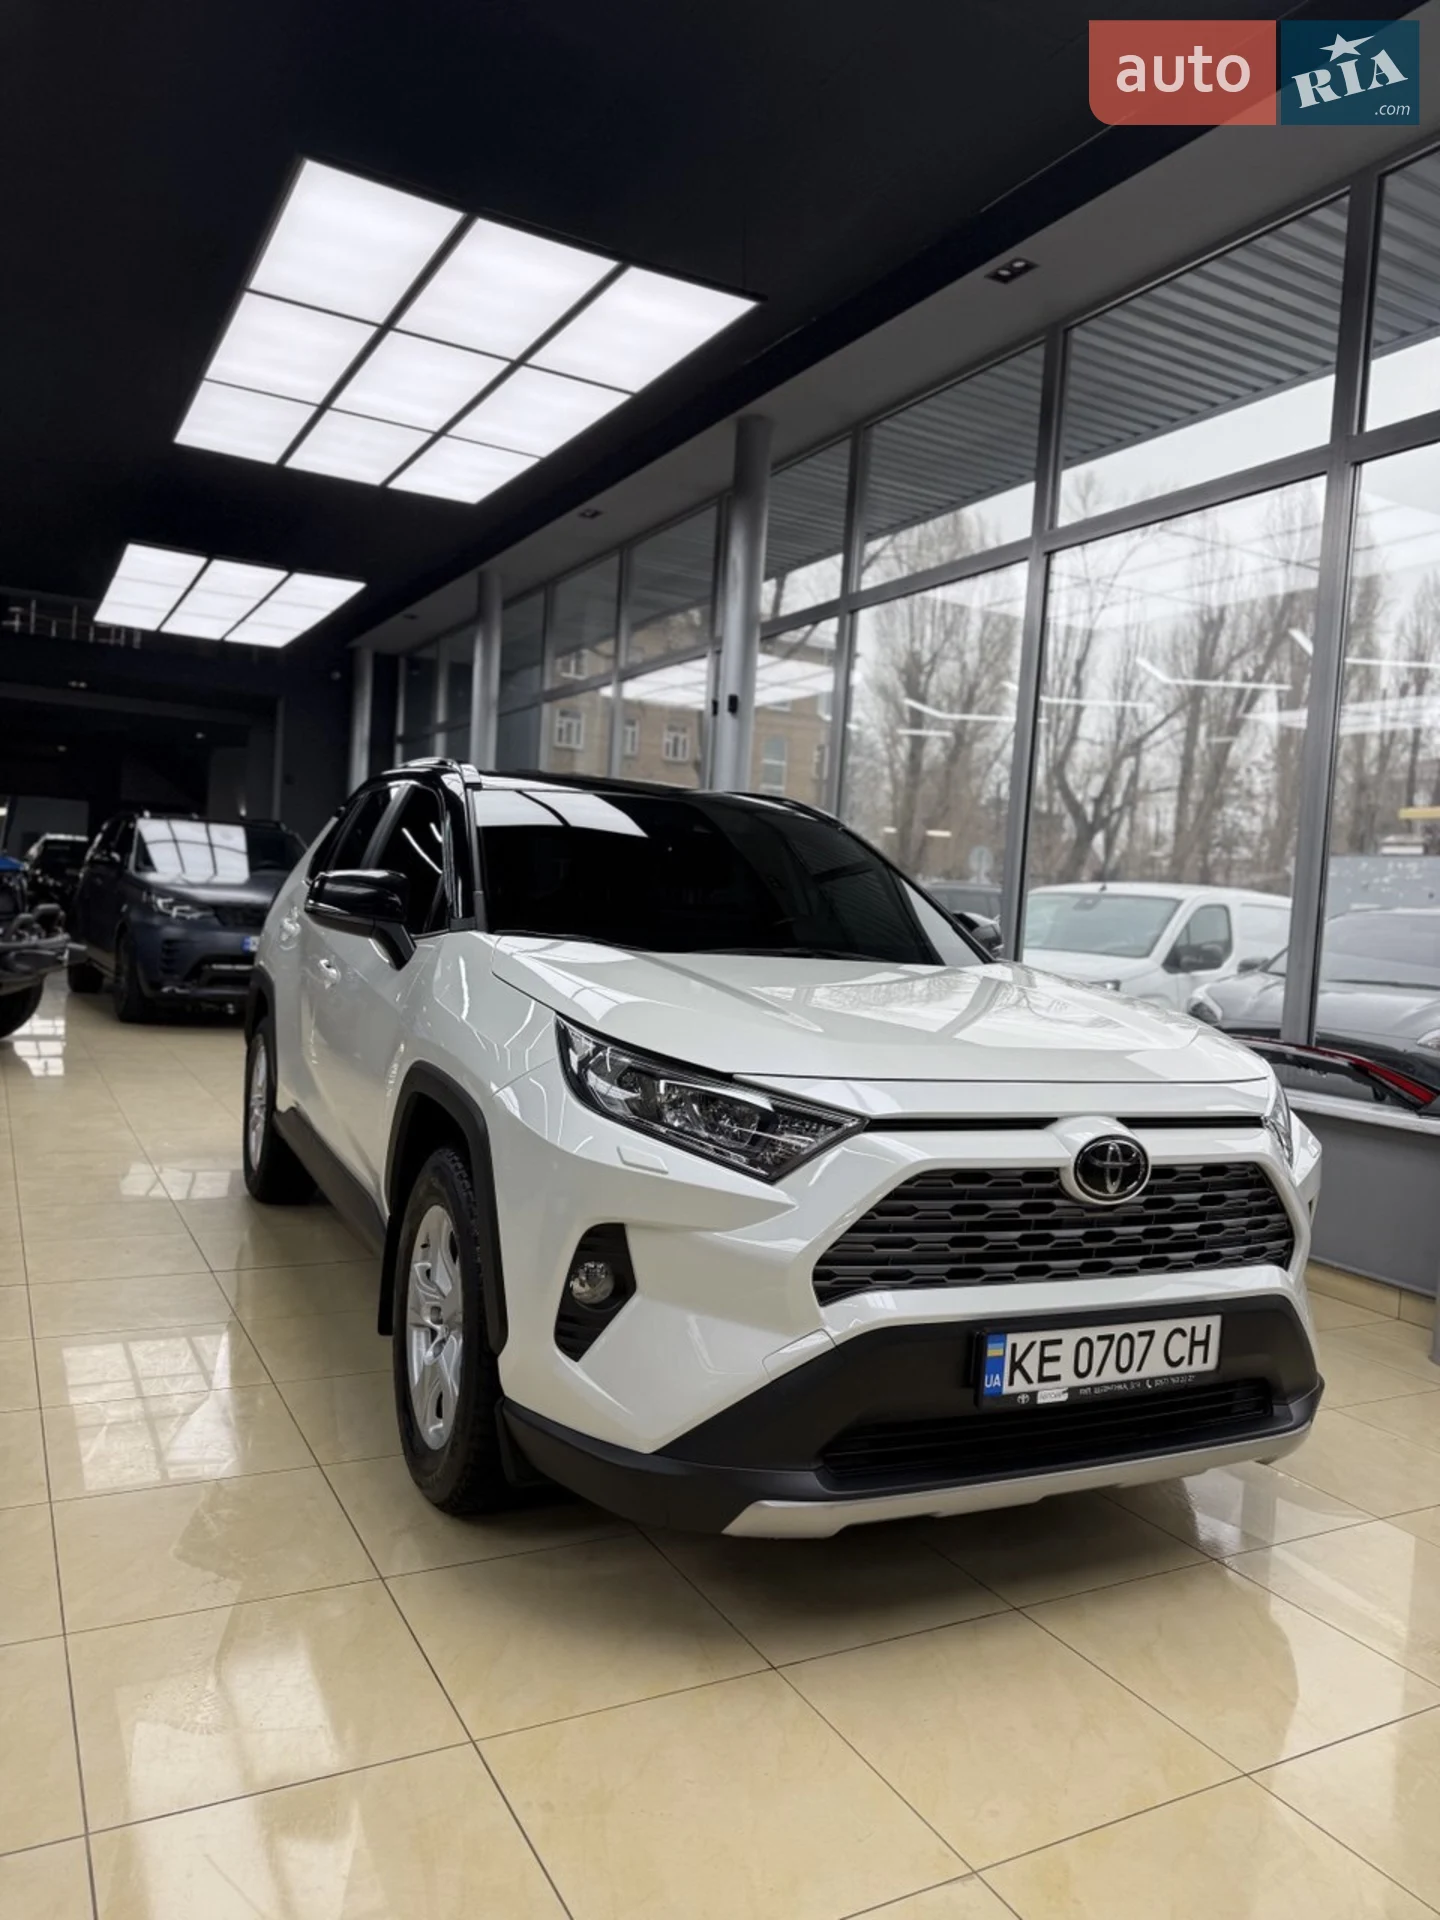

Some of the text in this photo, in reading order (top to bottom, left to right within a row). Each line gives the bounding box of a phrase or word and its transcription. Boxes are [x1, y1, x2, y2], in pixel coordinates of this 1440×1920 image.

[1008, 1338, 1063, 1387] KE
[1073, 1330, 1156, 1379] 0707
[1163, 1324, 1212, 1368] CH
[984, 1373, 1002, 1389] UA
